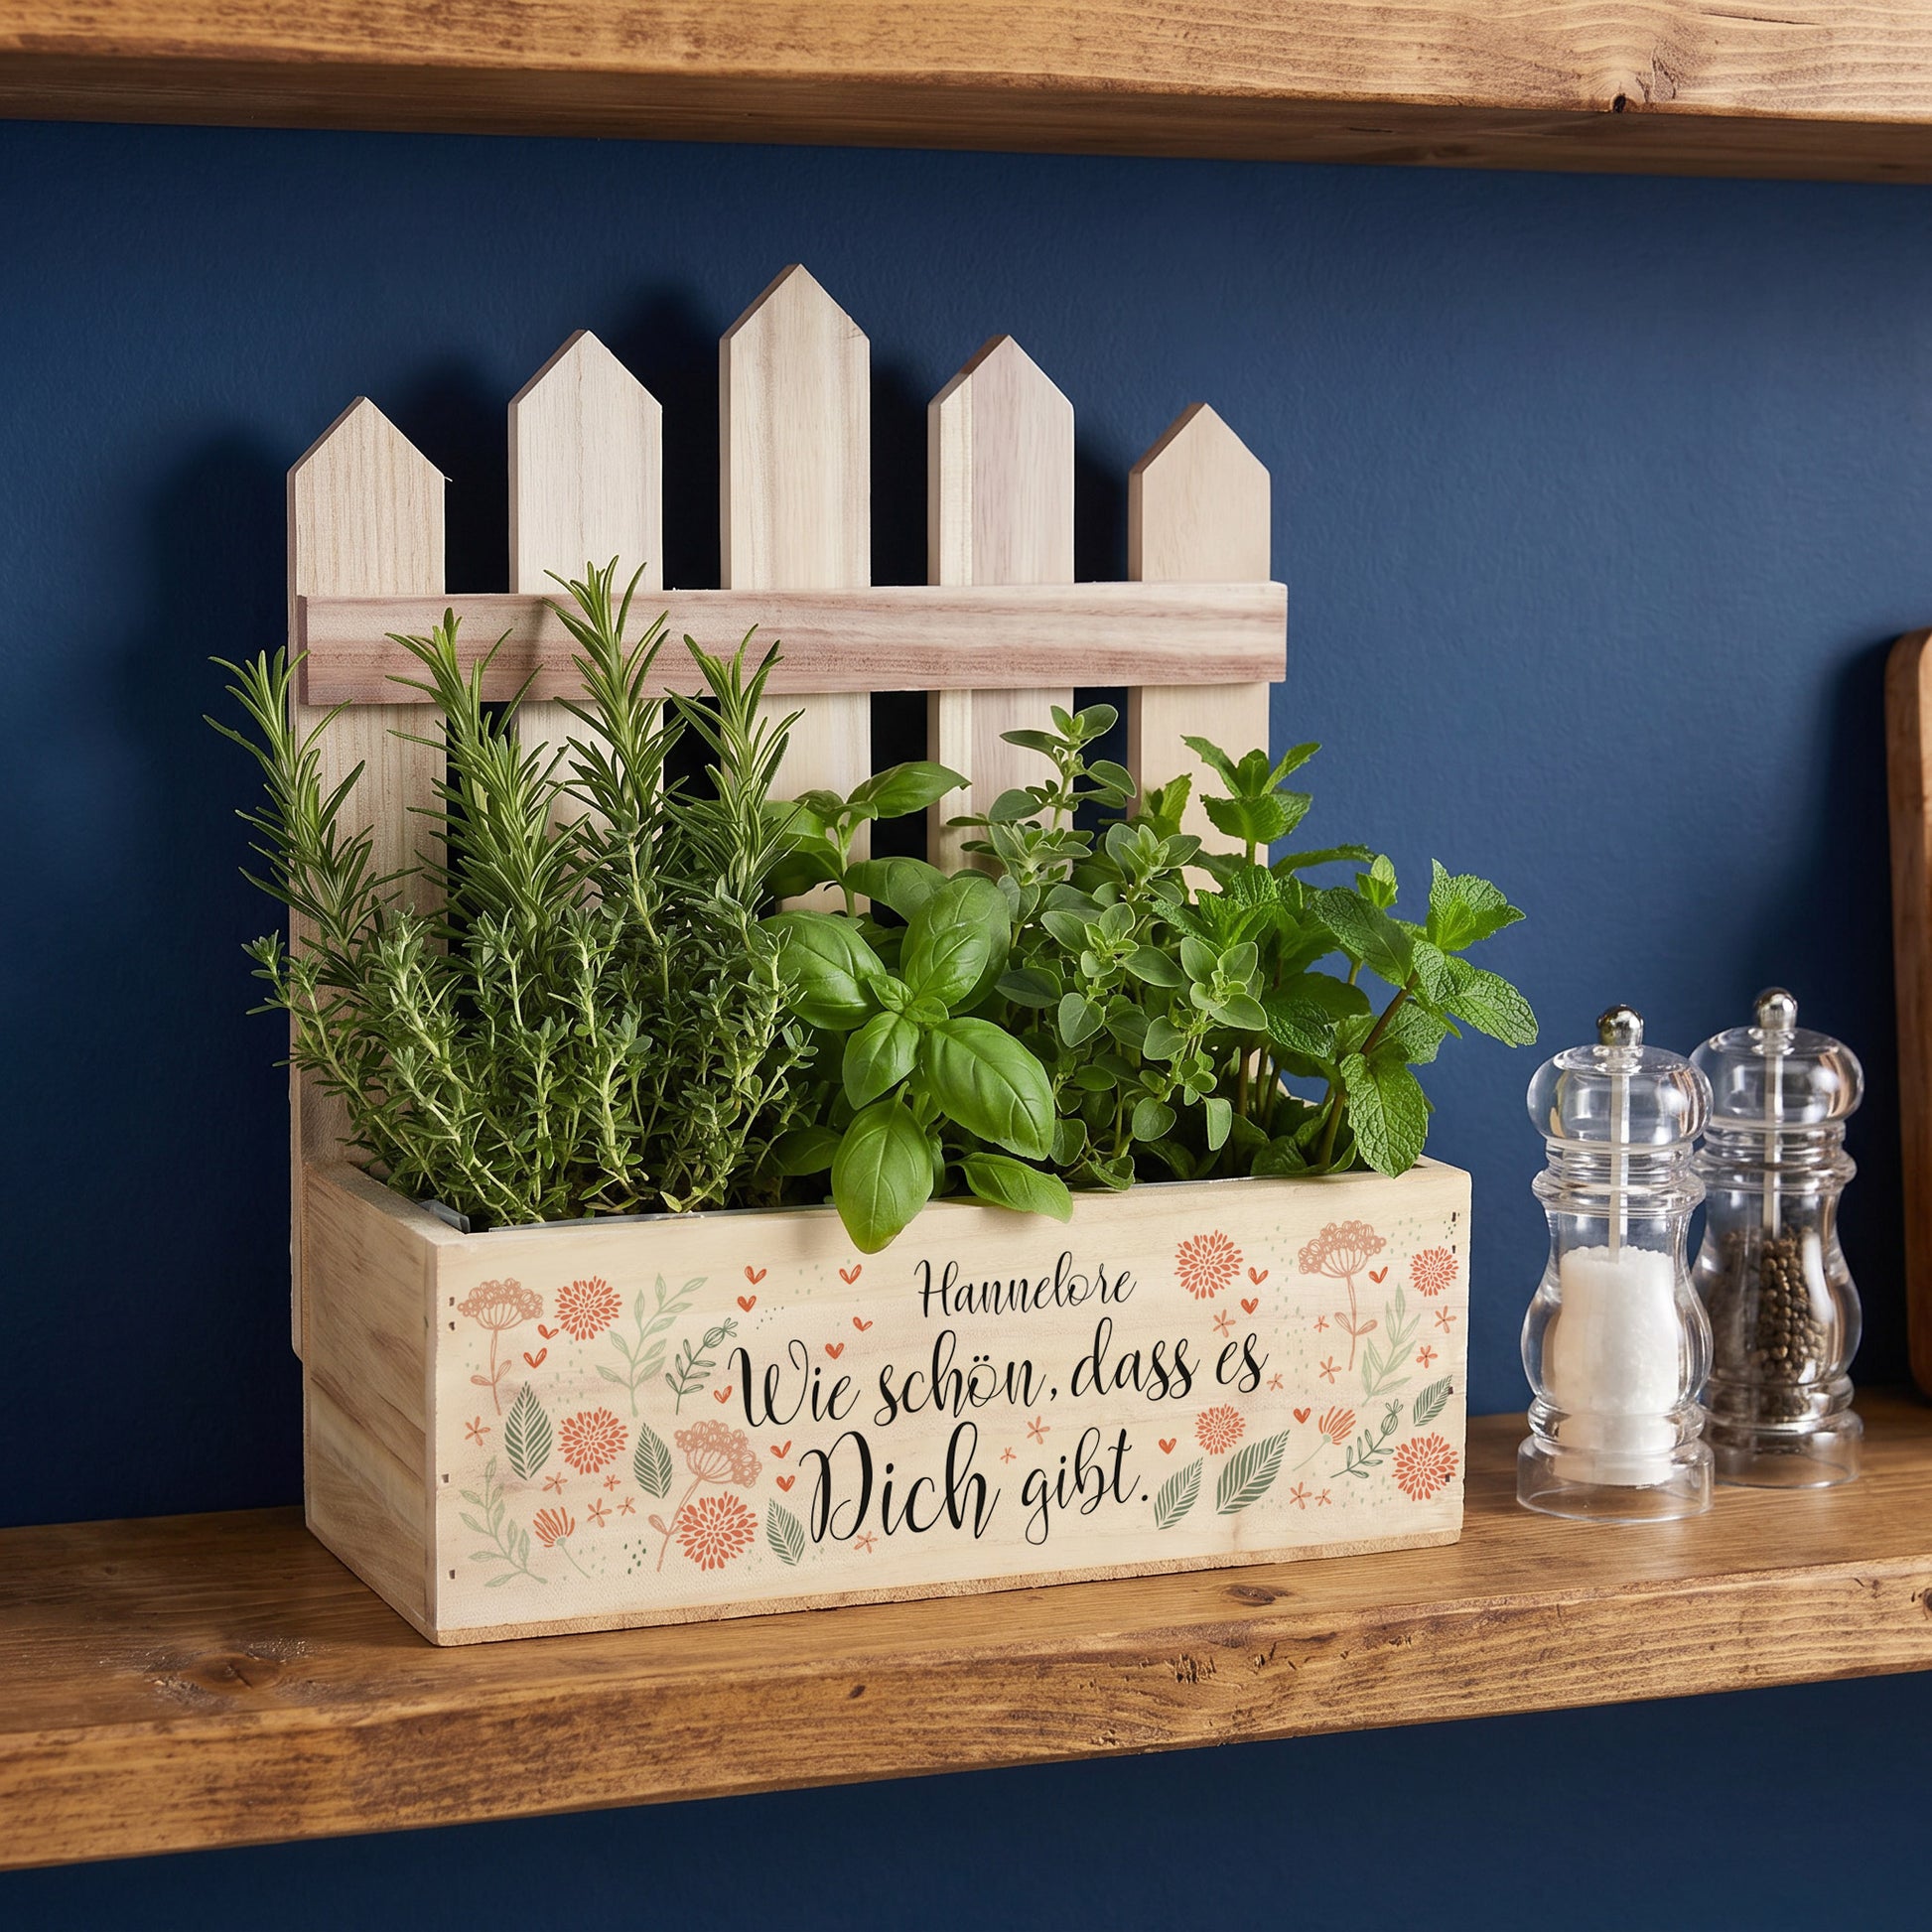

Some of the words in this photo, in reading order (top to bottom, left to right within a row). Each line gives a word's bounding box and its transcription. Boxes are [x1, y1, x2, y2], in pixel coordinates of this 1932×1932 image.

[914, 1251, 1136, 1318] Hannelore
[728, 1338, 861, 1428] Wie
[874, 1329, 1058, 1427] schön,
[1071, 1316, 1200, 1401] dass
[1215, 1332, 1270, 1394] es
[798, 1421, 1001, 1544] Dich
[1021, 1427, 1149, 1546] gibt.
